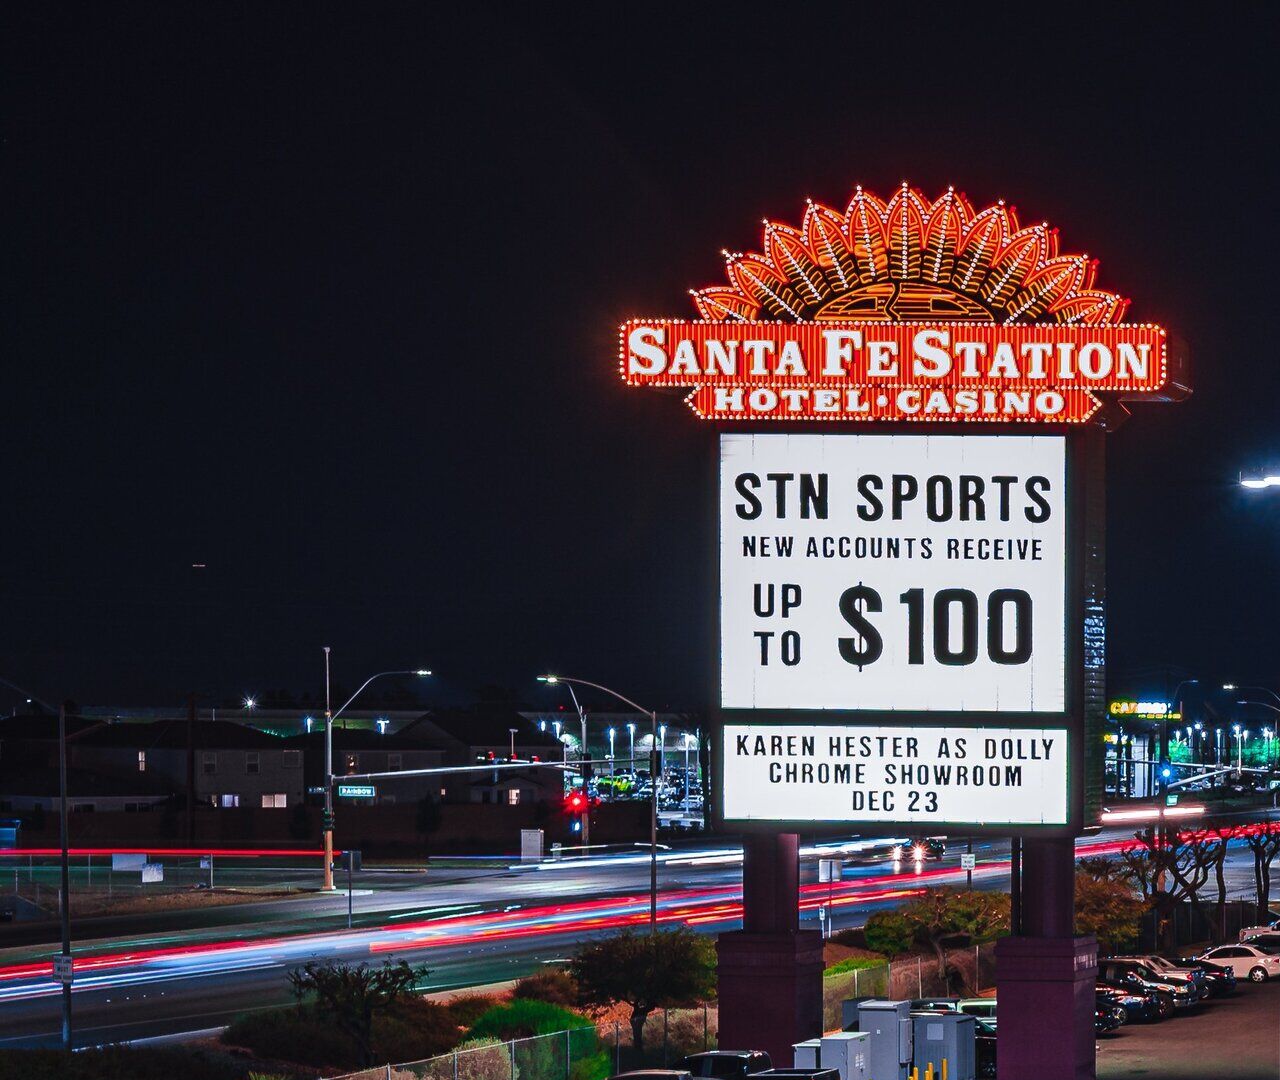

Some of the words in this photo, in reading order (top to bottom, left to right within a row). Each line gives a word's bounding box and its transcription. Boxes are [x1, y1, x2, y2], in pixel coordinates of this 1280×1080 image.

[628, 326, 808, 377] SANTA
[821, 329, 899, 378] FE
[912, 329, 1151, 380] STATION
[713, 387, 871, 413] HOTEL
[896, 389, 1066, 416] CASINO
[735, 472, 829, 521] STN
[856, 474, 1051, 524] SPORTS
[742, 535, 794, 558] NEW
[806, 536, 933, 560] ACCOUNTS
[947, 538, 1042, 561] RECEIVE
[753, 583, 802, 619] UP
[837, 581, 1033, 673] $100
[753, 629, 801, 667] TO
[736, 734, 815, 757] KAREN
[829, 735, 918, 758] HESTER
[937, 737, 967, 759] AS
[984, 738, 1053, 760] DOLLY
[769, 762, 866, 785] CHROME
[885, 763, 1022, 787] SHOWROOM
[852, 790, 895, 812] DEC
[908, 790, 938, 813] 23
